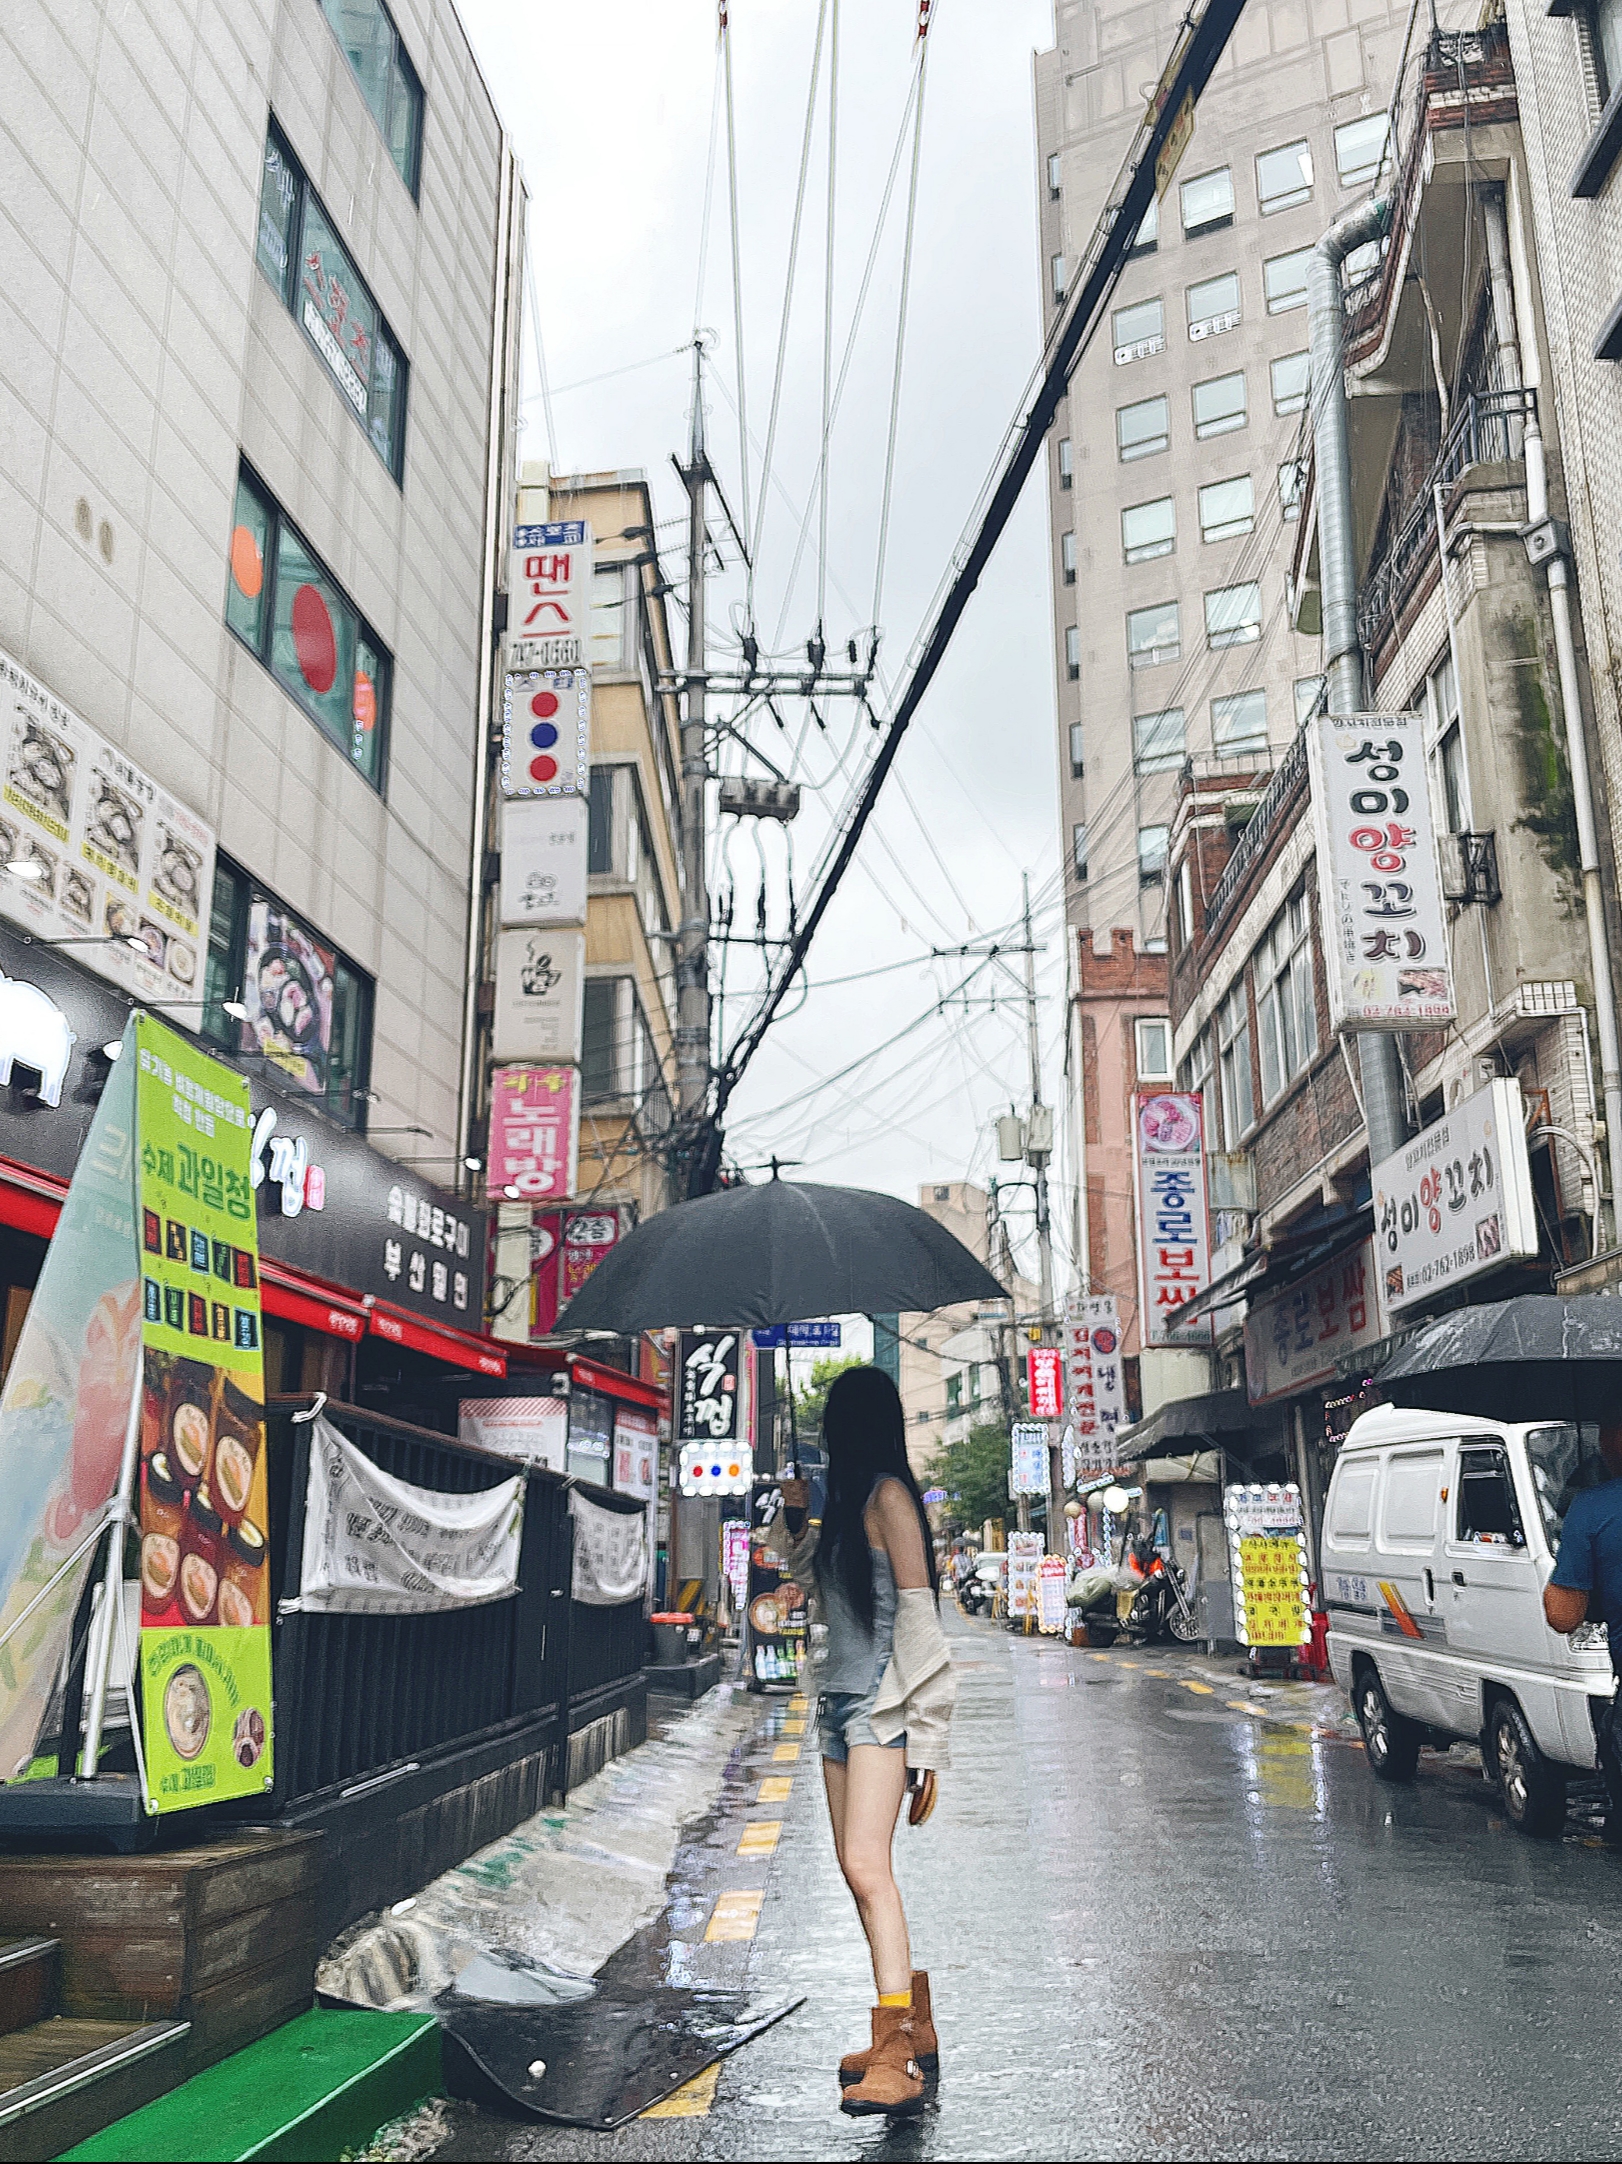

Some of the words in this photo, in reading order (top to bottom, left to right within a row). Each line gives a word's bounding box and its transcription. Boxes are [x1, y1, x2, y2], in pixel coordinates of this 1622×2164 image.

[523, 553, 571, 638] 땐스
[143, 1139, 174, 1186] 수제
[177, 1141, 251, 1219] 과일청
[502, 1097, 564, 1194] 노래방
